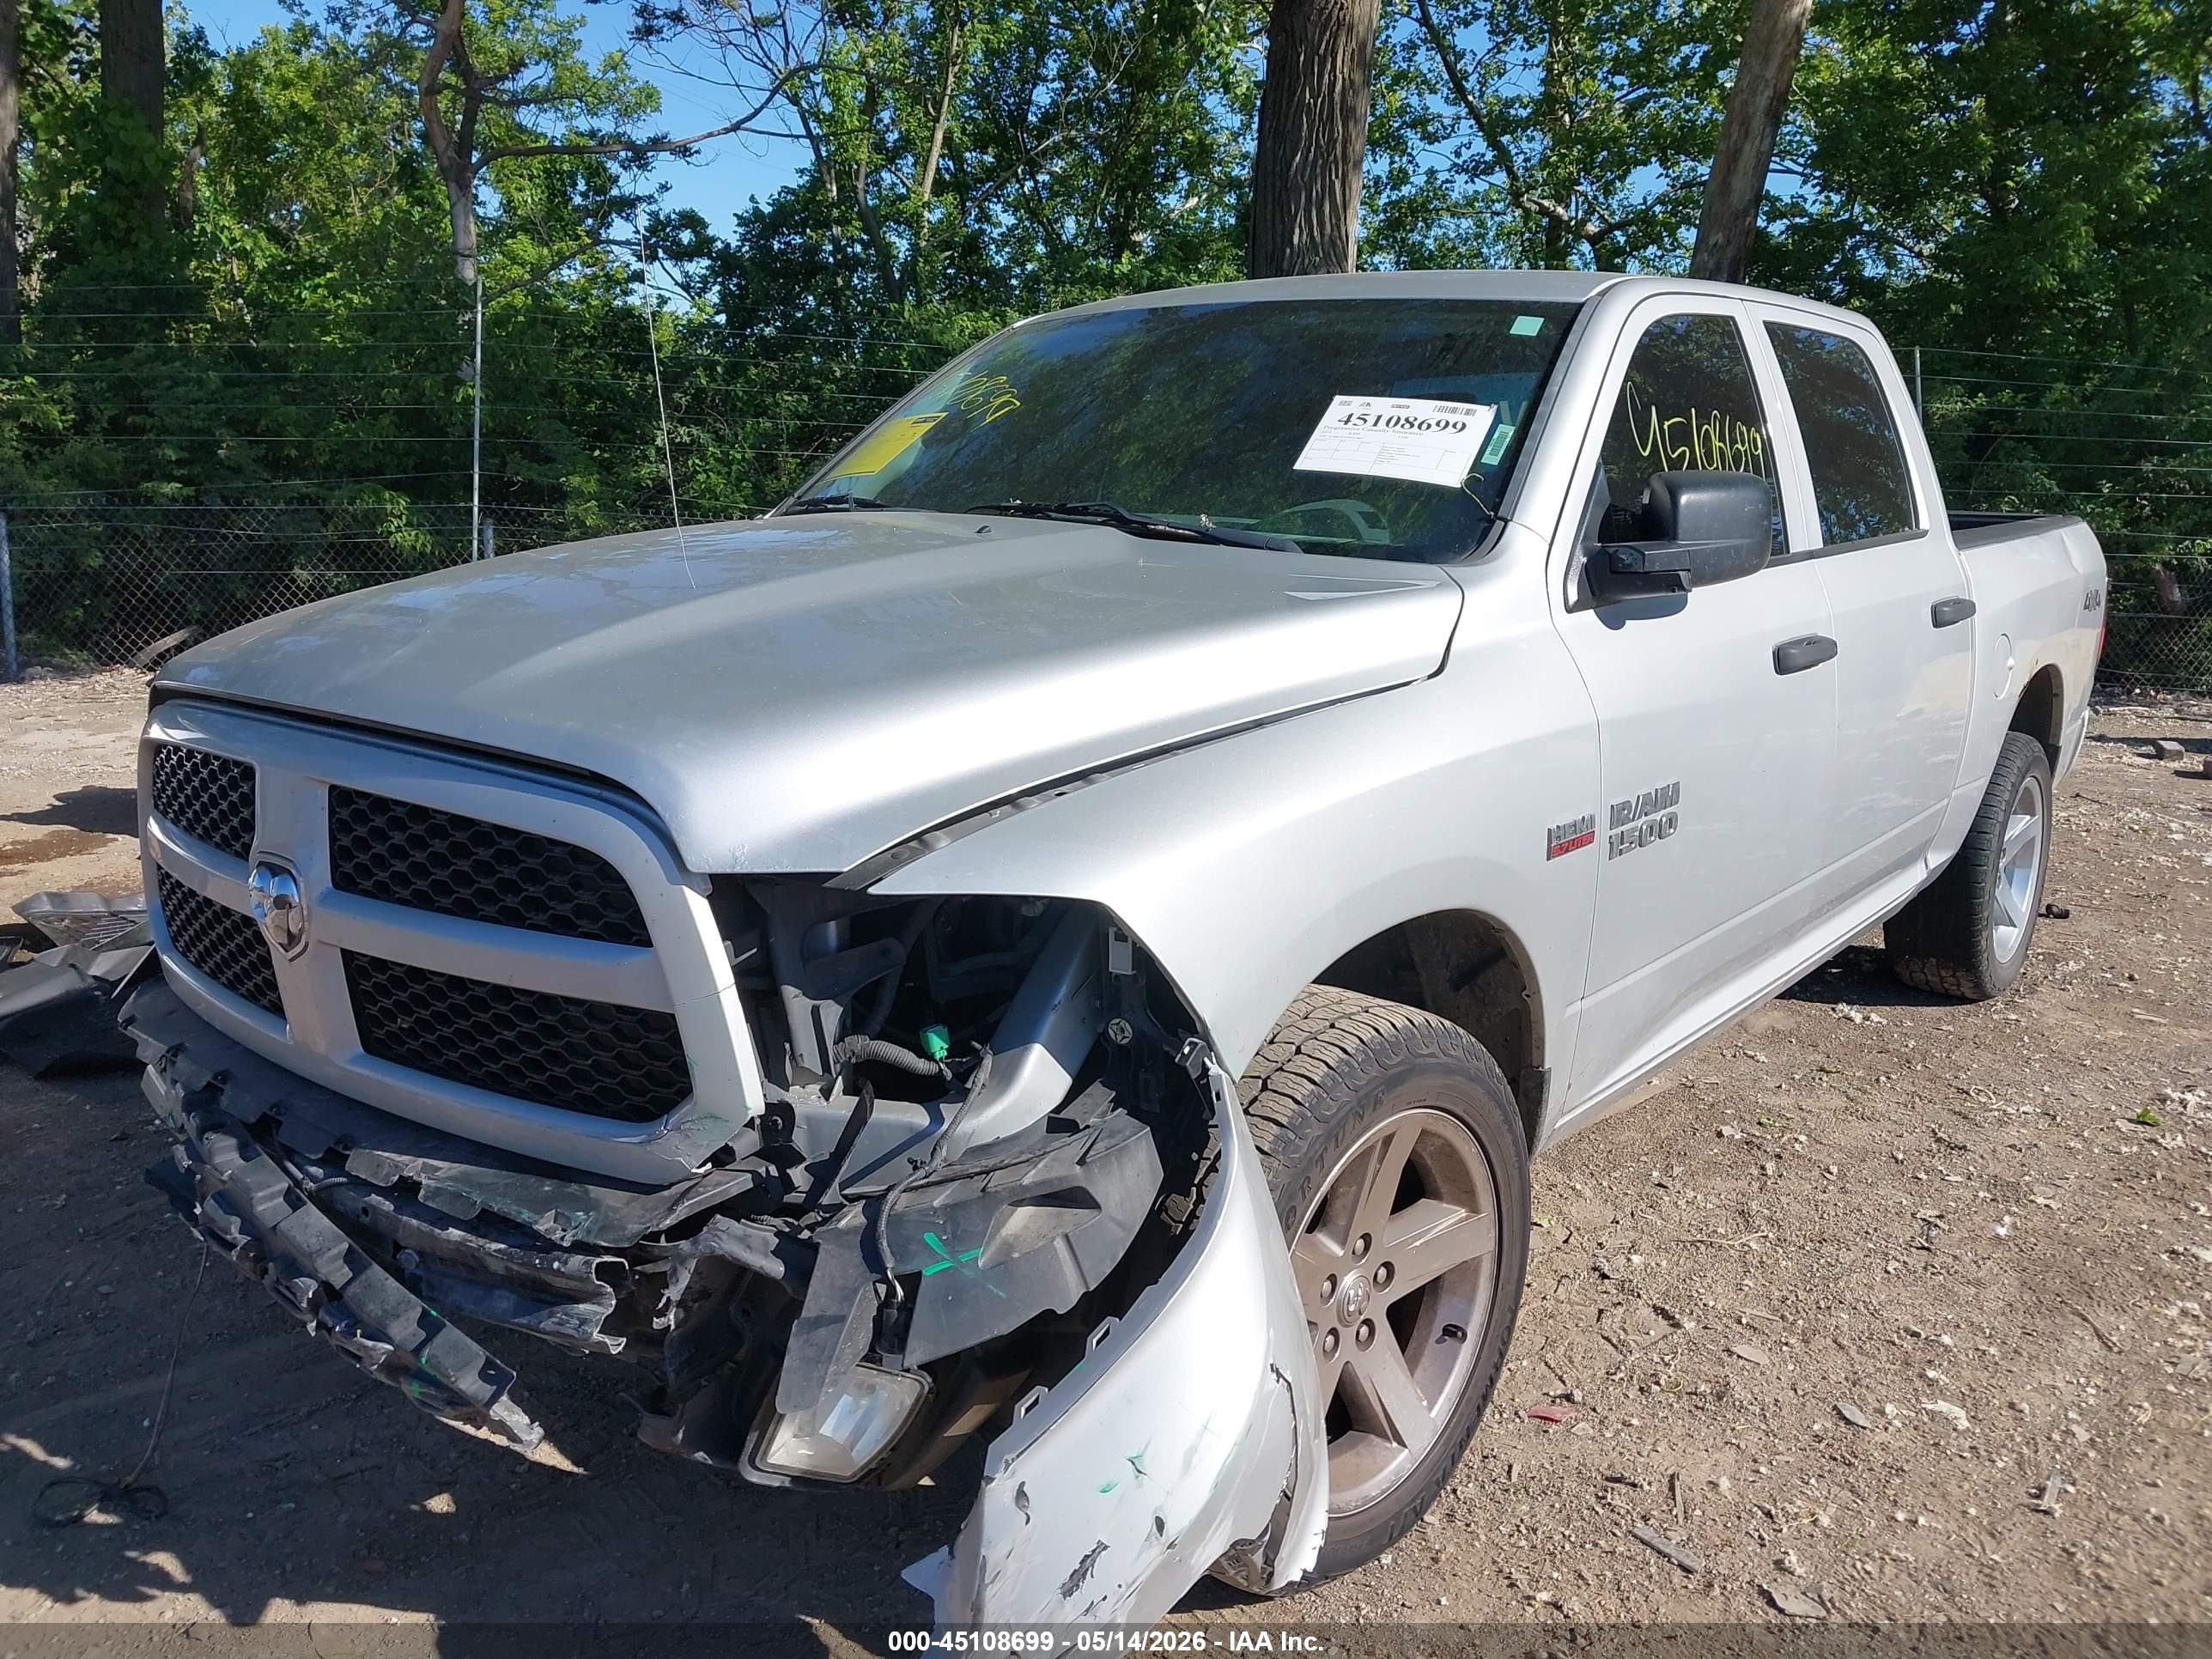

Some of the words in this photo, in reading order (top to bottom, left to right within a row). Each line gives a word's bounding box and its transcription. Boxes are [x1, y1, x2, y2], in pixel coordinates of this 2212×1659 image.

[1337, 412, 1468, 434] 45108699
[1626, 381, 1766, 482] 45108699
[1547, 813, 1595, 847] HEMI
[1609, 781, 1680, 830] RAM
[1608, 811, 1679, 861] 1500
[1284, 1085, 1387, 1232] ORTUNE
